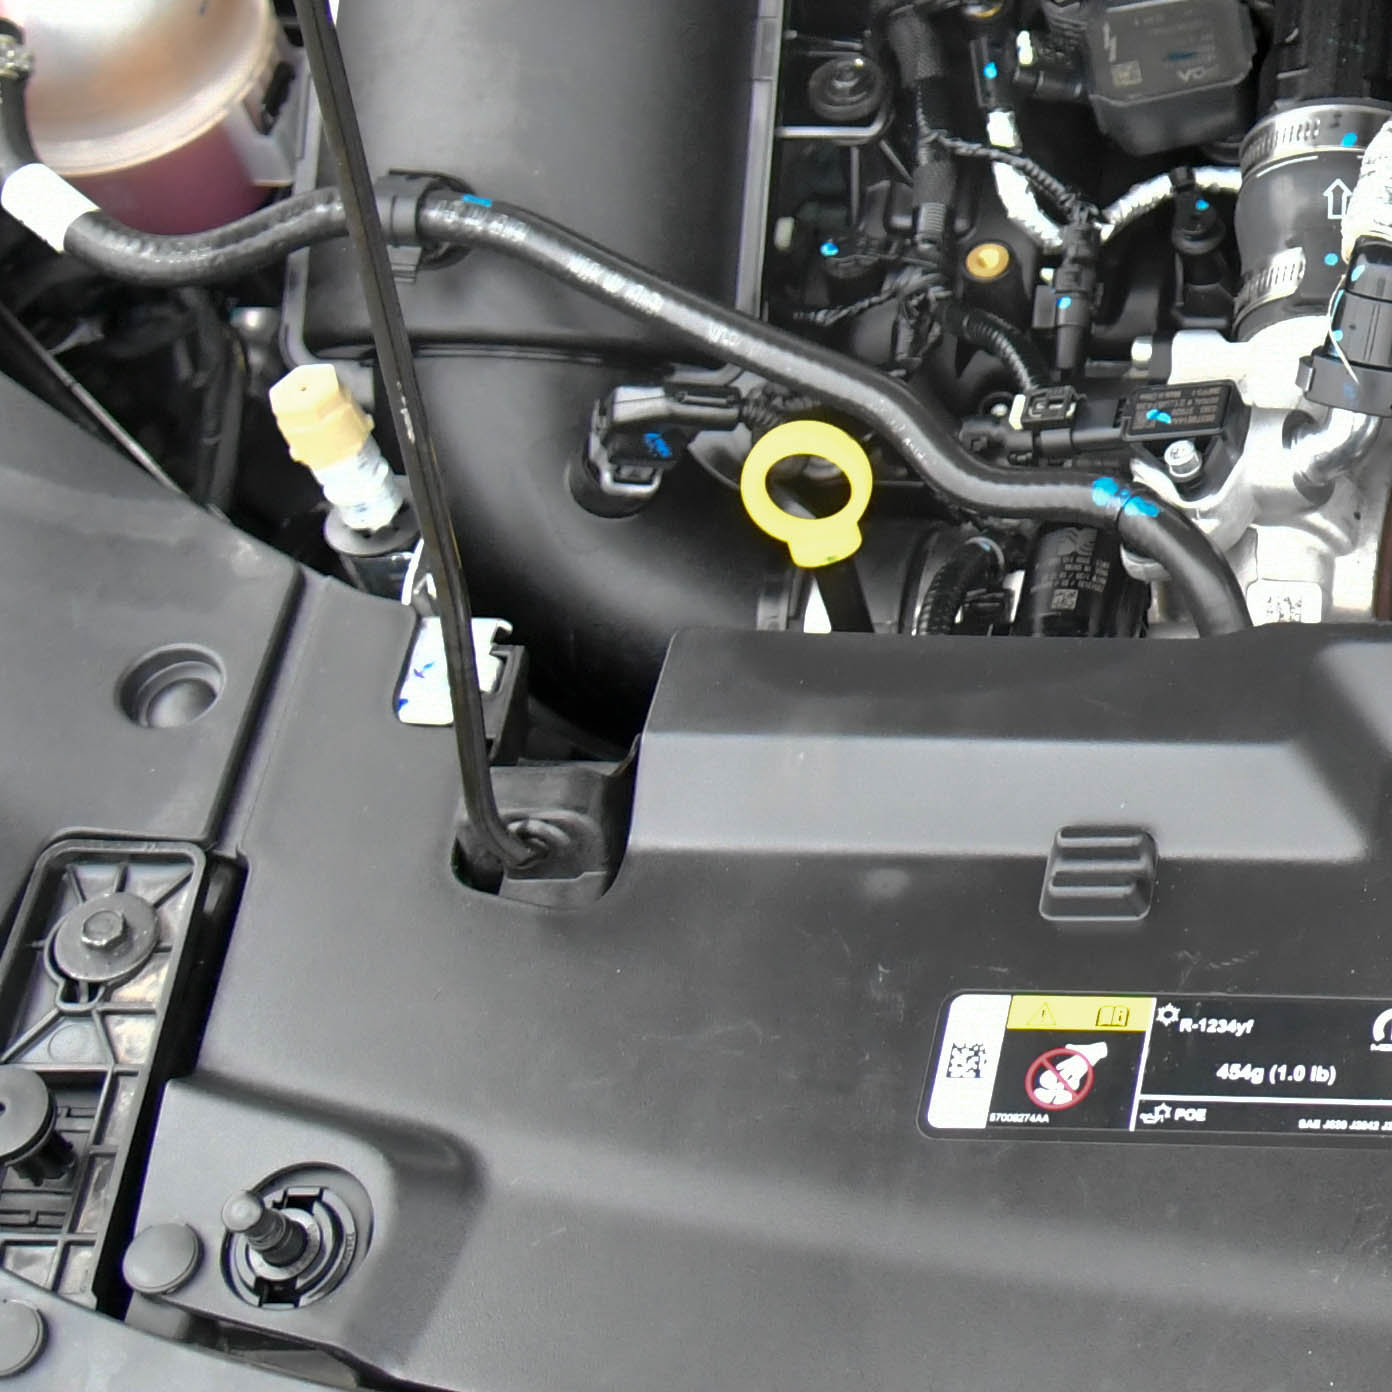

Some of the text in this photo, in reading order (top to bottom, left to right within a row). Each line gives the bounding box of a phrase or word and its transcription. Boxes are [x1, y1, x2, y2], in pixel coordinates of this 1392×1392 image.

[1179, 1018, 1255, 1037] R-1234yf
[1216, 1063, 1337, 1086] 454g (1.0 lb)
[1174, 1108, 1207, 1122] POE
